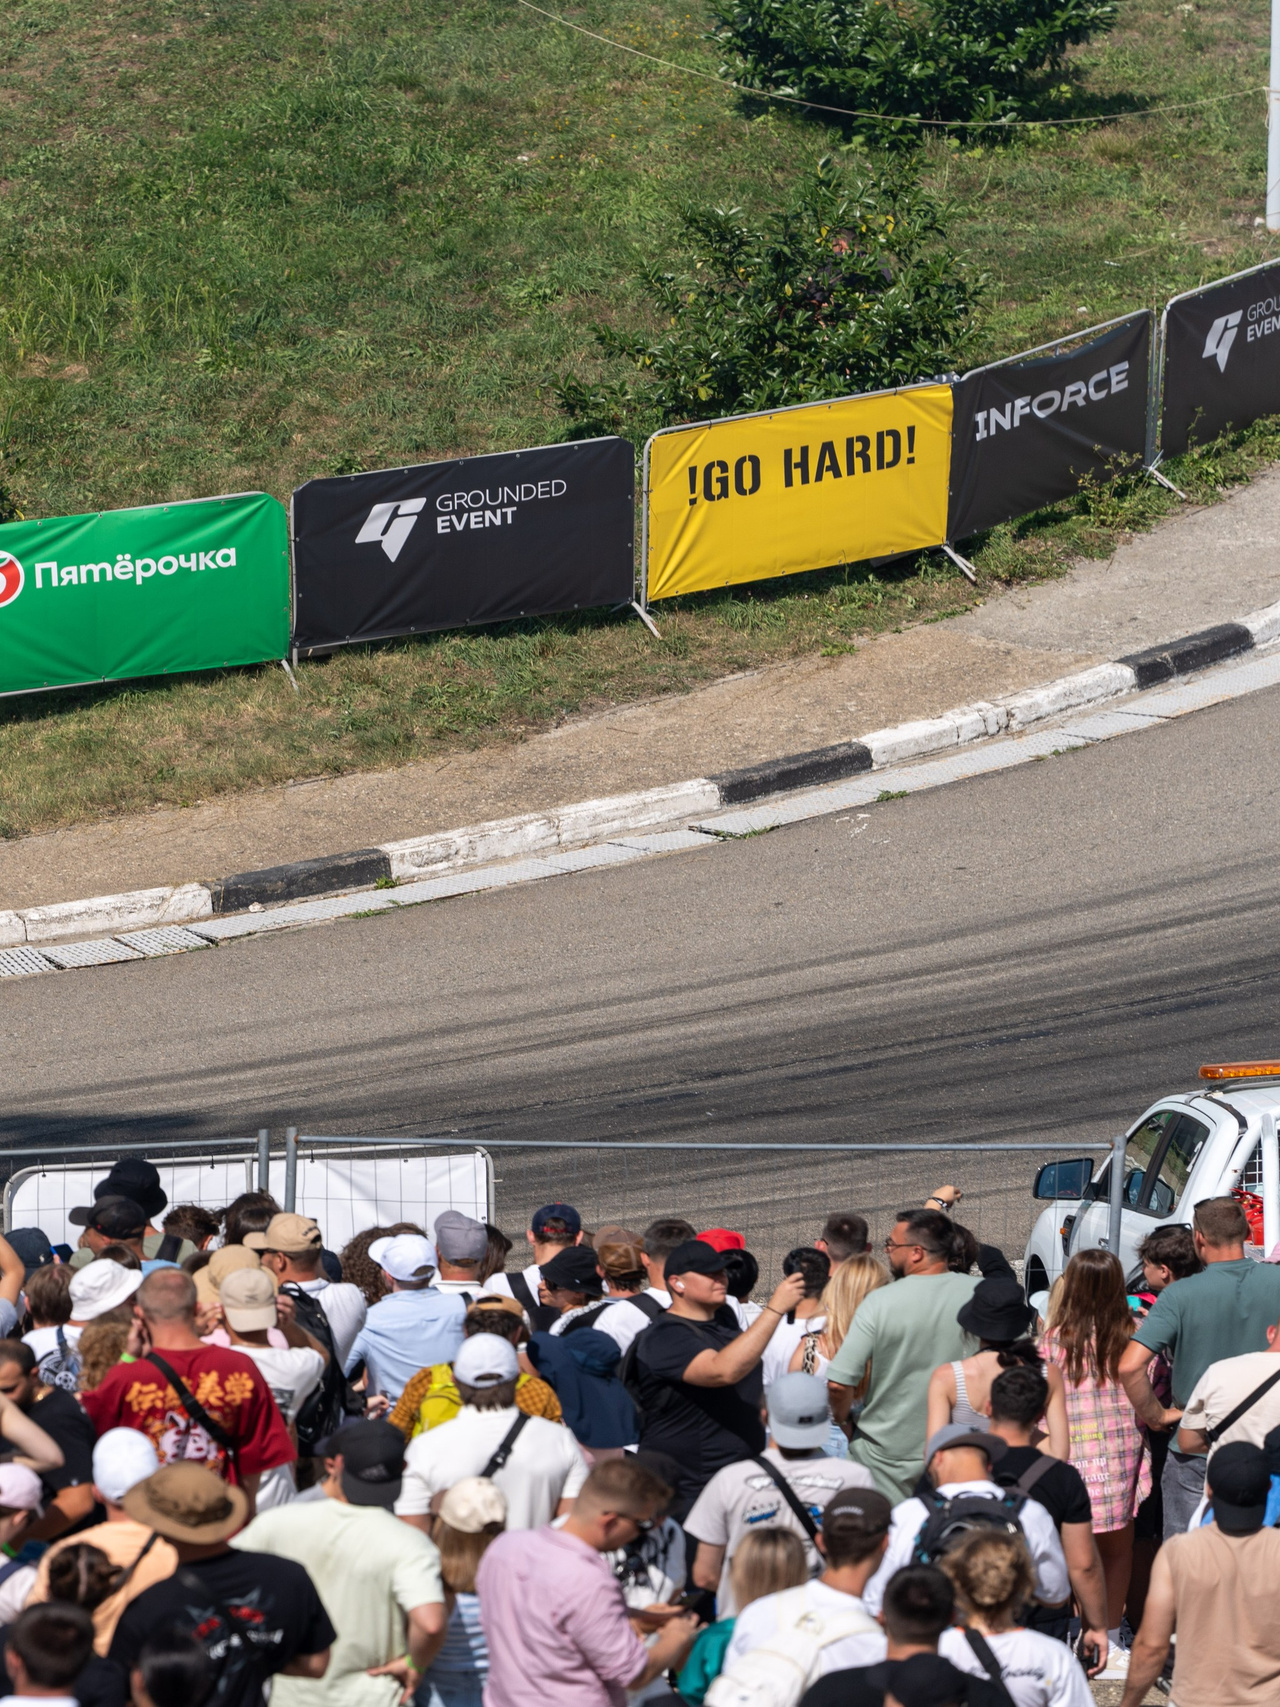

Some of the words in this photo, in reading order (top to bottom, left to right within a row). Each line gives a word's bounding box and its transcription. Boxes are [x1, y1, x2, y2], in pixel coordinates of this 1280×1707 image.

[975, 360, 1129, 442] INFORCE
[688, 454, 761, 506] !GO
[783, 425, 916, 488] HARD!
[436, 479, 567, 512] GROUNDED
[437, 506, 517, 534] EVENT
[34, 547, 237, 589] Пятёрочка
